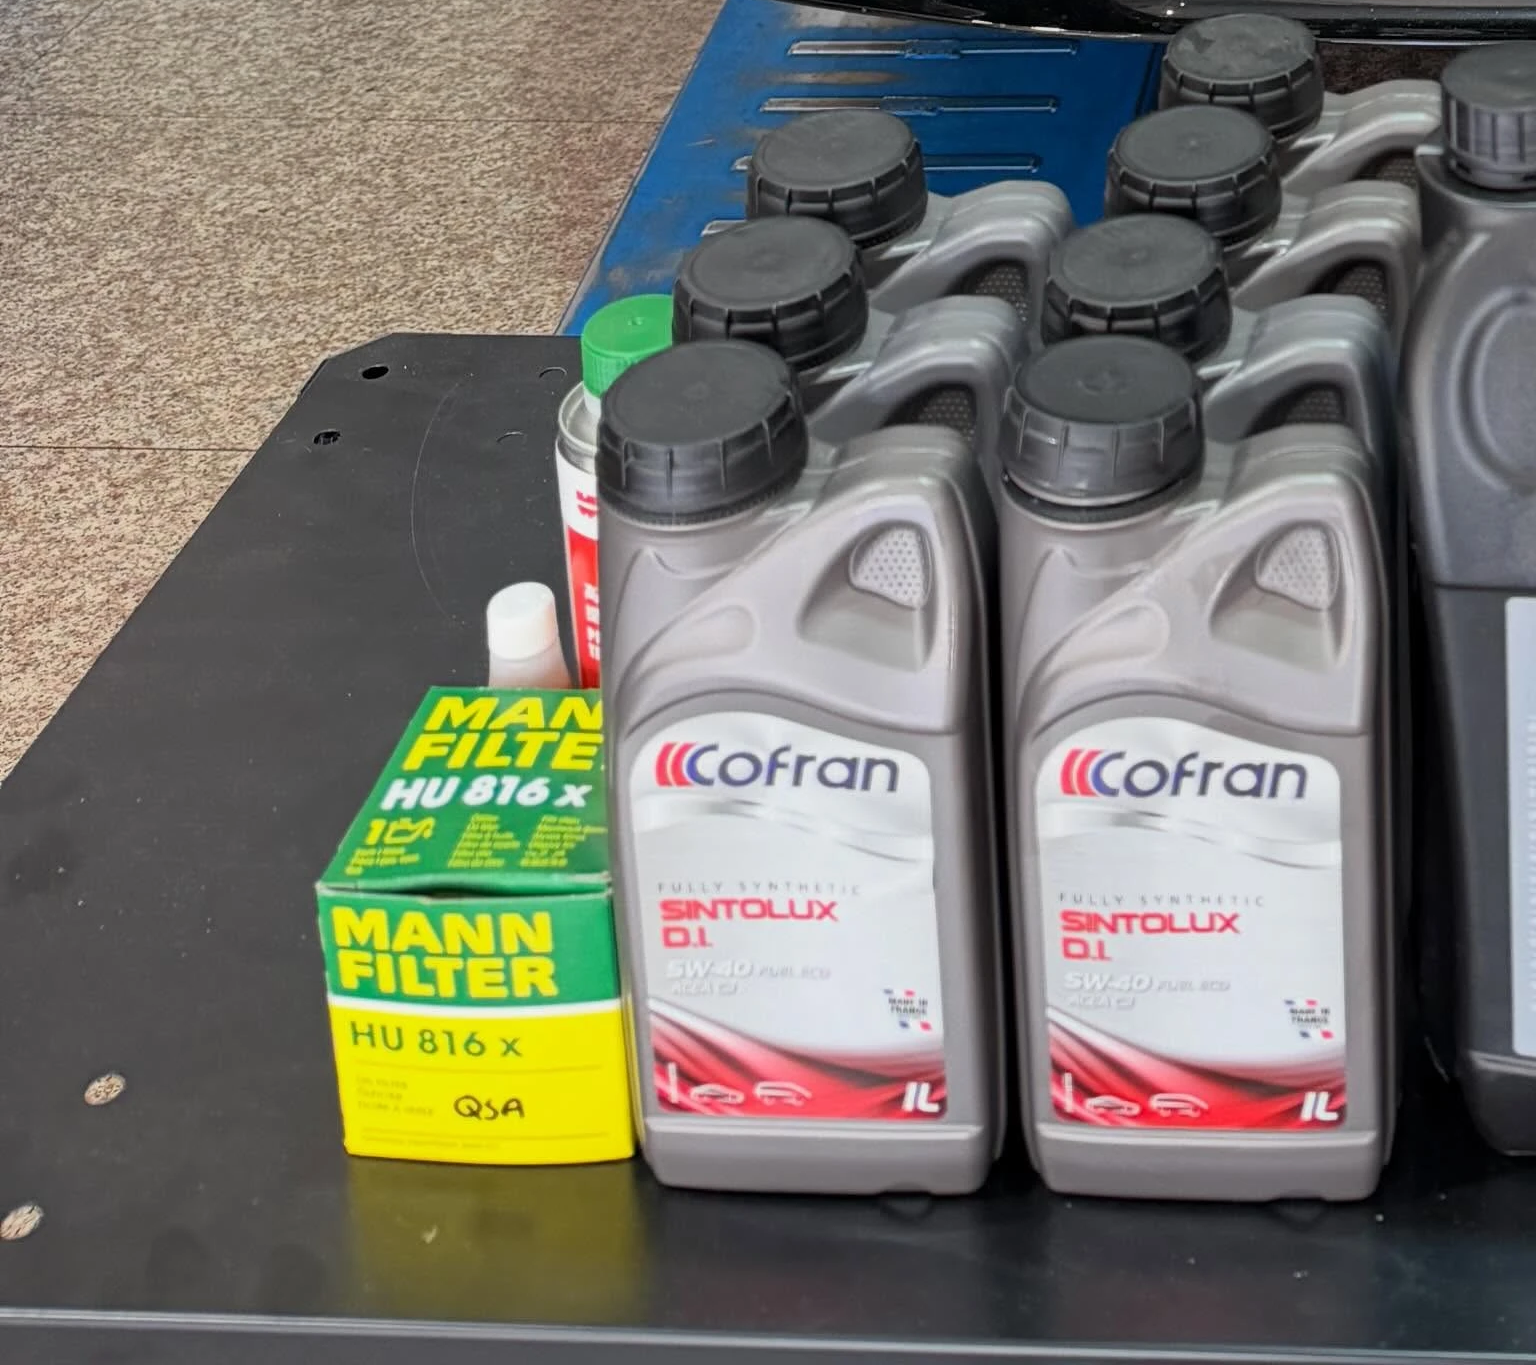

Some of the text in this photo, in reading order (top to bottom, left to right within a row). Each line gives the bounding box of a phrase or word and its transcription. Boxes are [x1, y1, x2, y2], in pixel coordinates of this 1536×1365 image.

[403, 733, 604, 771] FILTE
[686, 743, 899, 793] Cofran
[380, 777, 459, 809] HU
[462, 774, 551, 807] 816
[1092, 751, 1308, 798] Cofran
[658, 881, 860, 896] FULLY SYNTHETIC
[1060, 892, 1265, 907] FULLY SYNTHETIC
[659, 898, 838, 921] SINTOLUX
[1059, 909, 1240, 934] SINTOLUX
[331, 907, 554, 956] MANN
[338, 952, 559, 1000] FILTER
[350, 1021, 404, 1053] HU
[418, 1022, 486, 1058] 816
